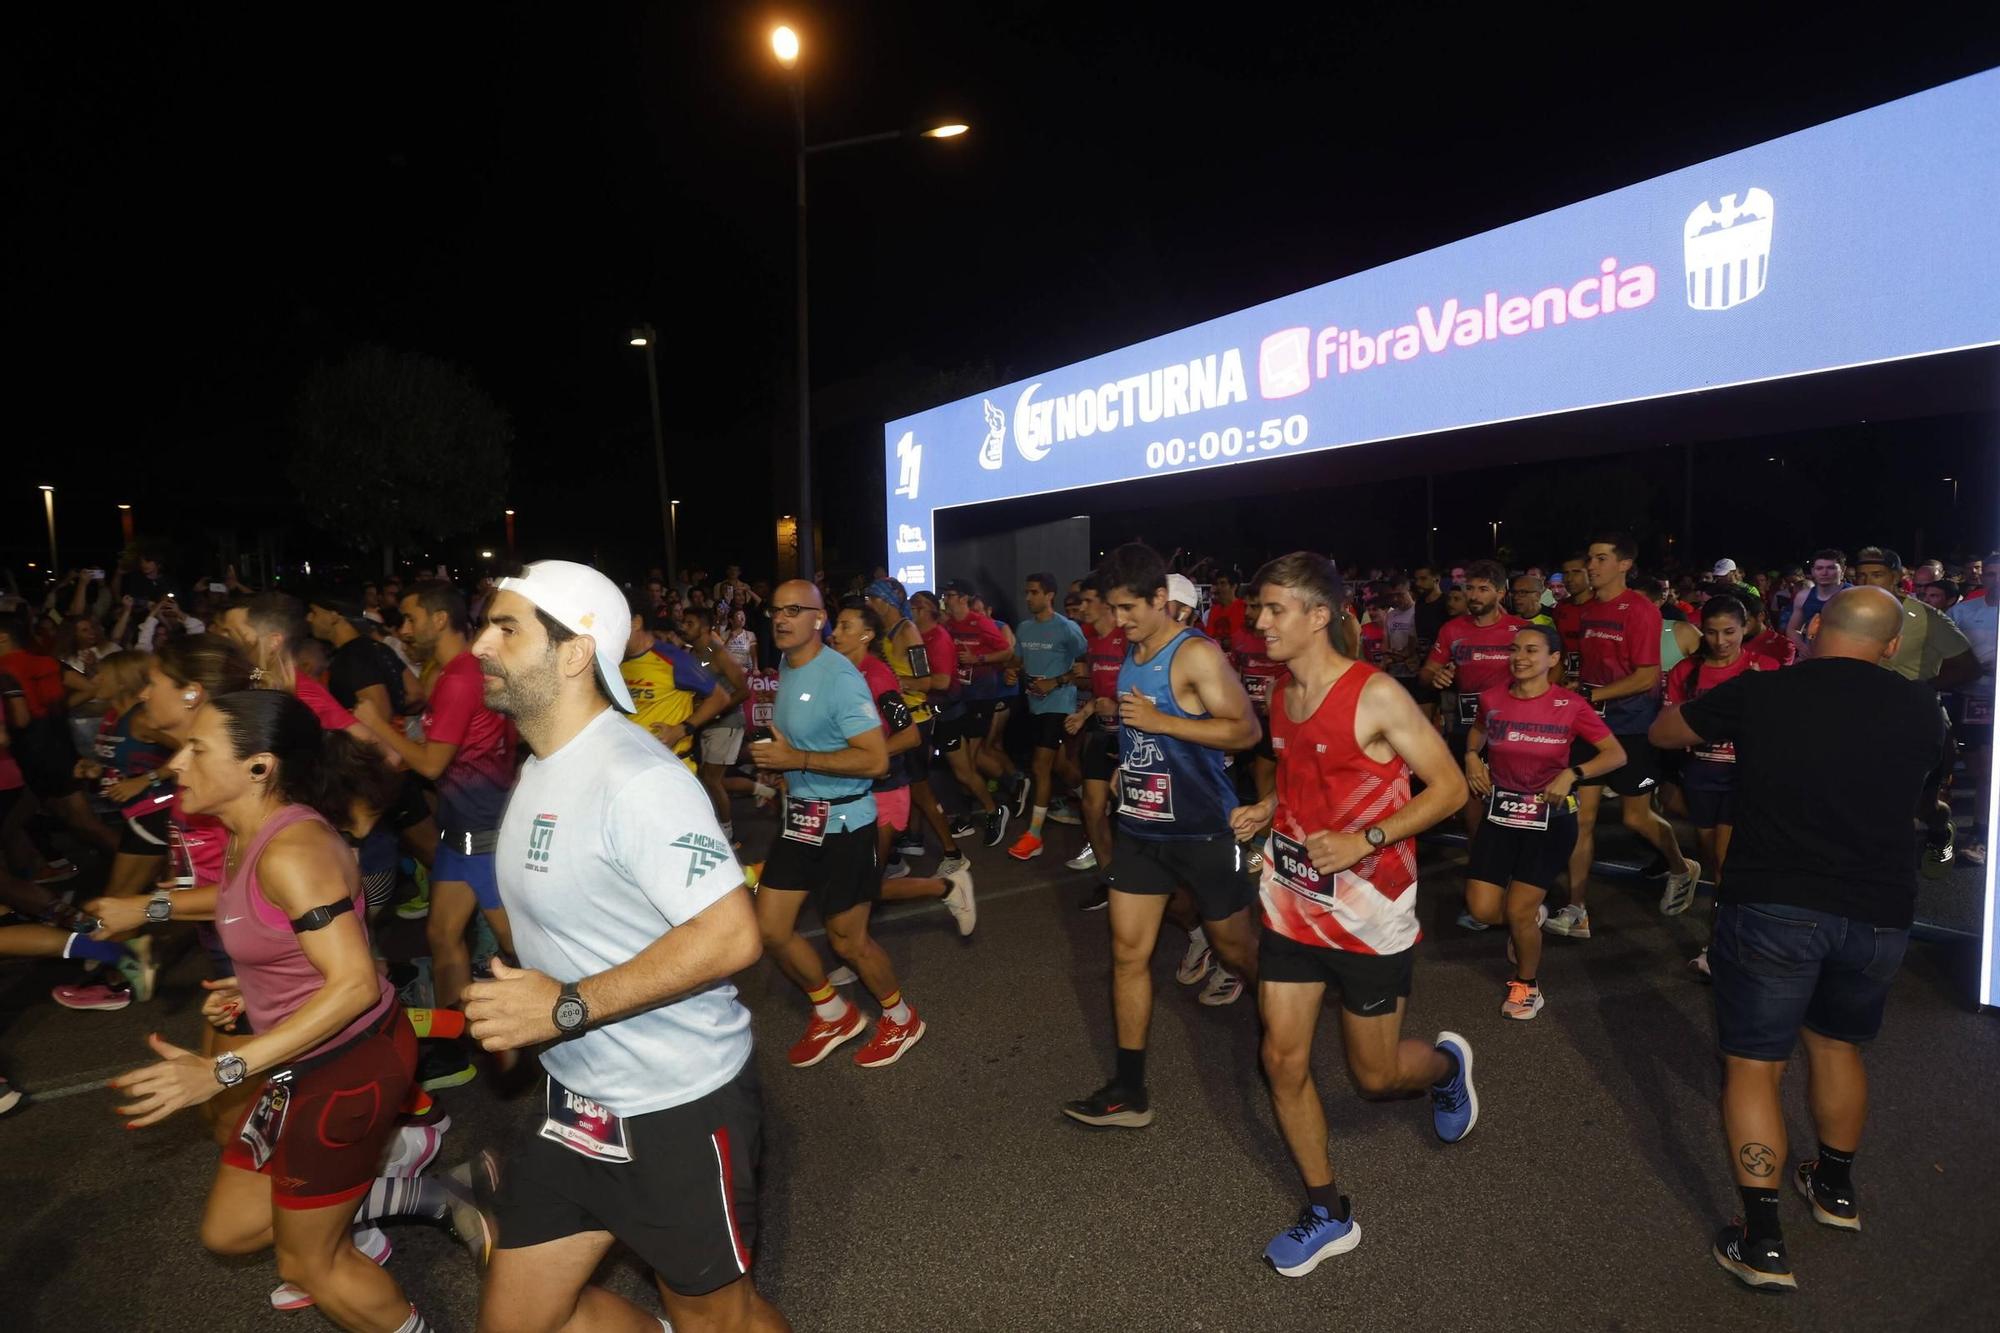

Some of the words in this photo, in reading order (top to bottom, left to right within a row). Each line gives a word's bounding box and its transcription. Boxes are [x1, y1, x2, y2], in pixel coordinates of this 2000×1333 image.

[1056, 348, 1248, 442] NOCTURNA
[1146, 414, 1309, 469] 00:00:50
[1126, 786, 1165, 805] 10295
[1500, 800, 1537, 814] 4232
[792, 812, 821, 828] 2233
[694, 833, 715, 850] MCM
[1282, 855, 1320, 882] 1506
